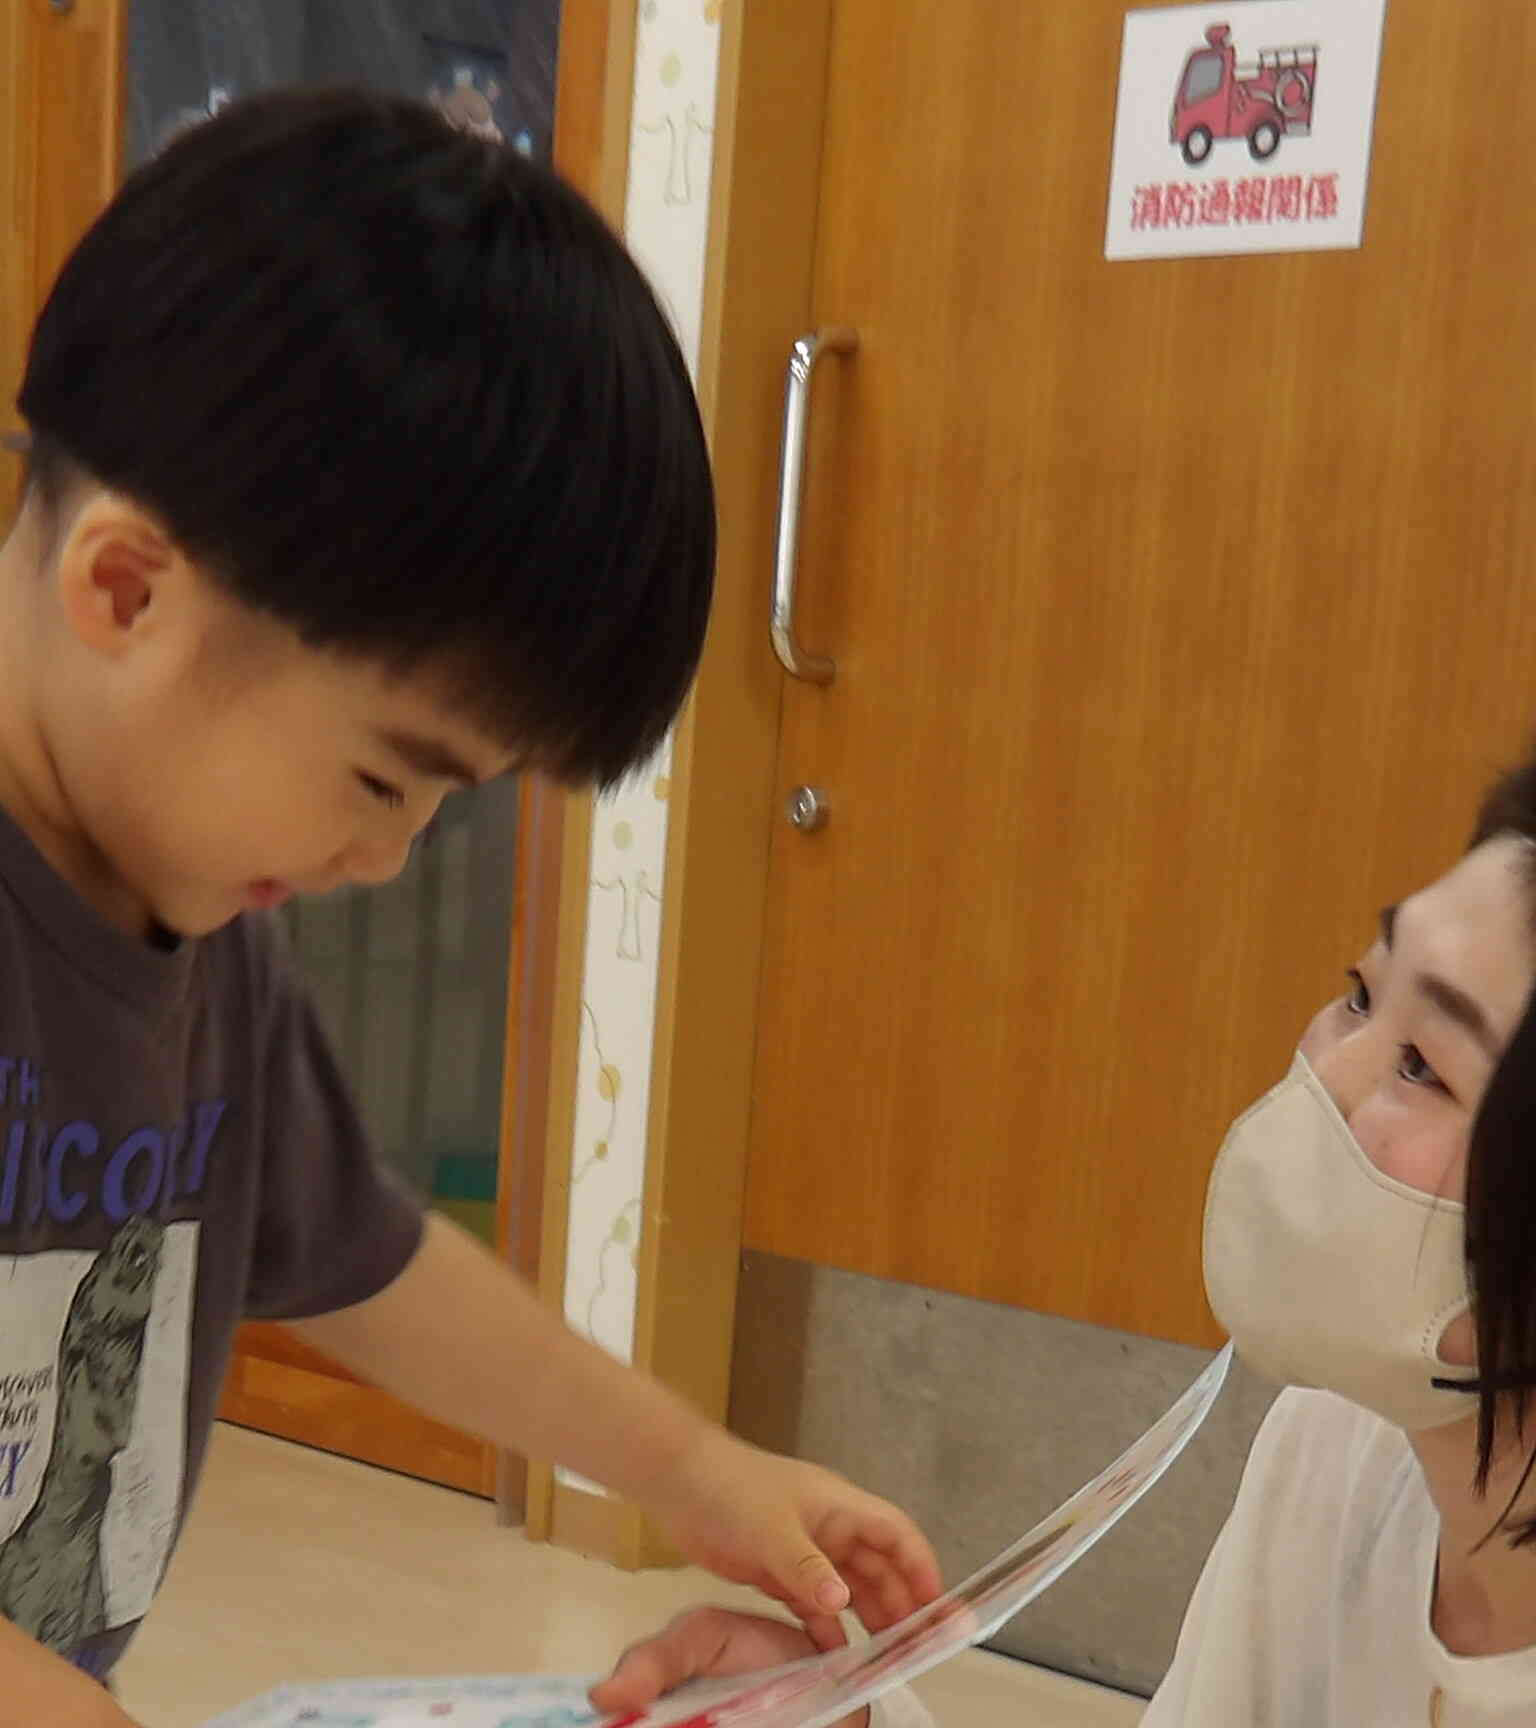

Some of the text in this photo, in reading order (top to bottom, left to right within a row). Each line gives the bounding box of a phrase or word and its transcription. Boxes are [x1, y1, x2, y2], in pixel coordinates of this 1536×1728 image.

[1130, 172, 1339, 232] 消防通報関係
